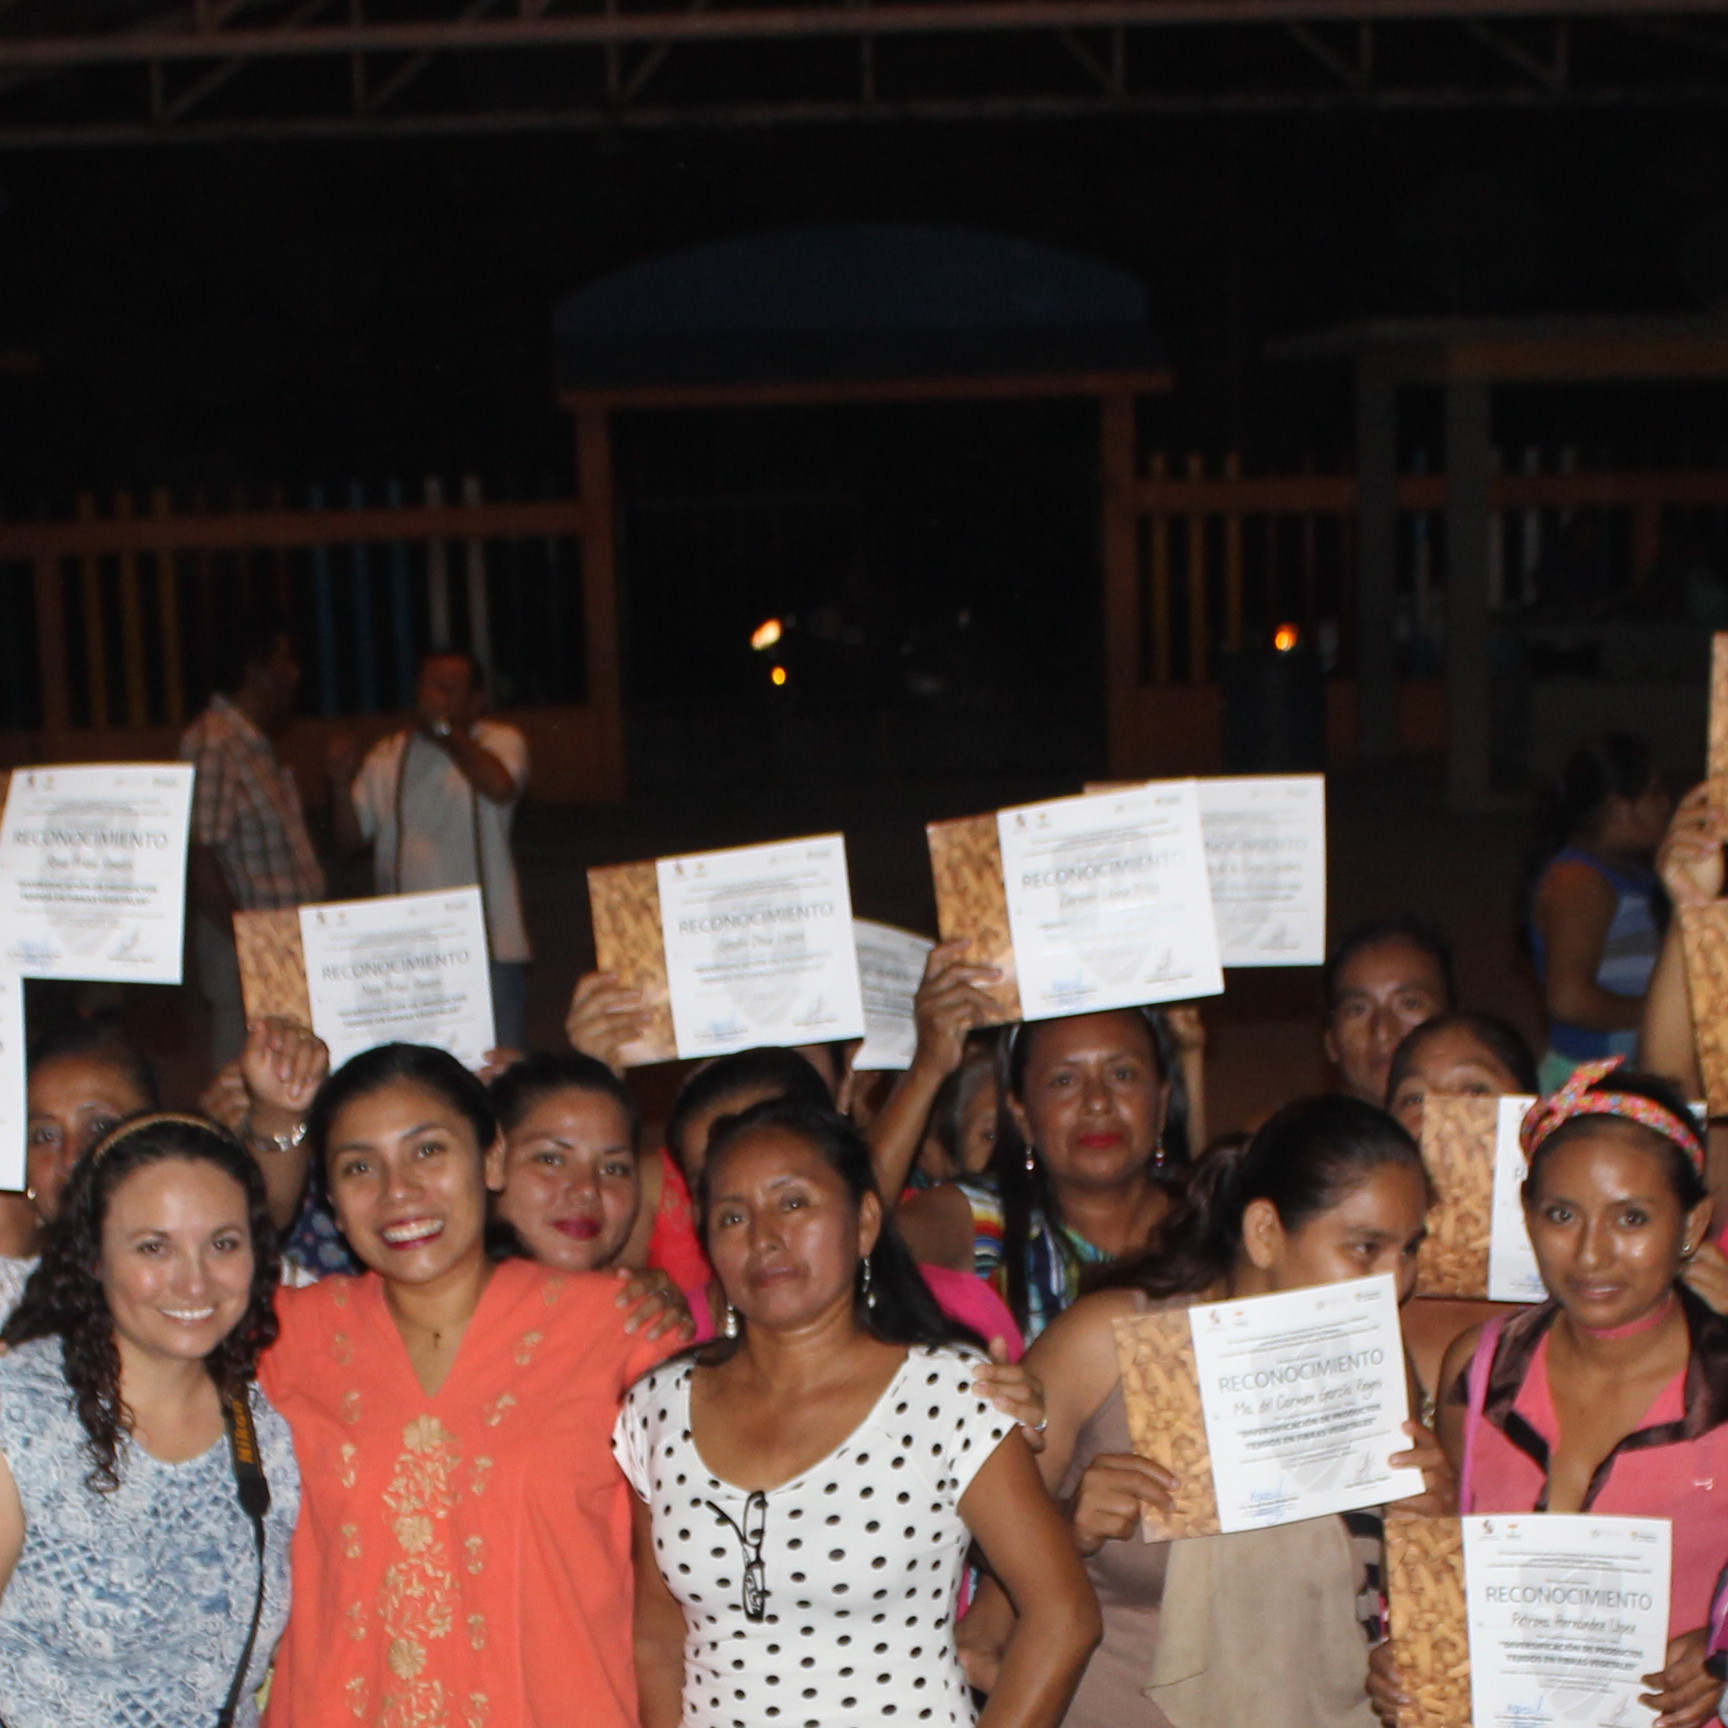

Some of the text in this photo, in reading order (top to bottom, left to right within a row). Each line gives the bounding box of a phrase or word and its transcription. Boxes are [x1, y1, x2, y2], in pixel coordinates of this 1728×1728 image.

[13, 828, 167, 849] RECONOCIMIENTO
[1022, 850, 1188, 890] RECONOCIMIENTO
[678, 903, 833, 934] RECONOCIMIENTO
[321, 951, 469, 981] RECONOCIMIENTO
[1218, 1348, 1383, 1395] RECONOCIMIENTO
[1316, 1414, 1327, 1423] DE
[1283, 1434, 1294, 1443] EN
[1296, 1428, 1326, 1440] FIBRAS
[1486, 1586, 1652, 1611] RECONOCIMIENTO
[1578, 1646, 1589, 1655] DE
[1542, 1657, 1553, 1666] EN
[1556, 1658, 1586, 1668] FIBRAS
